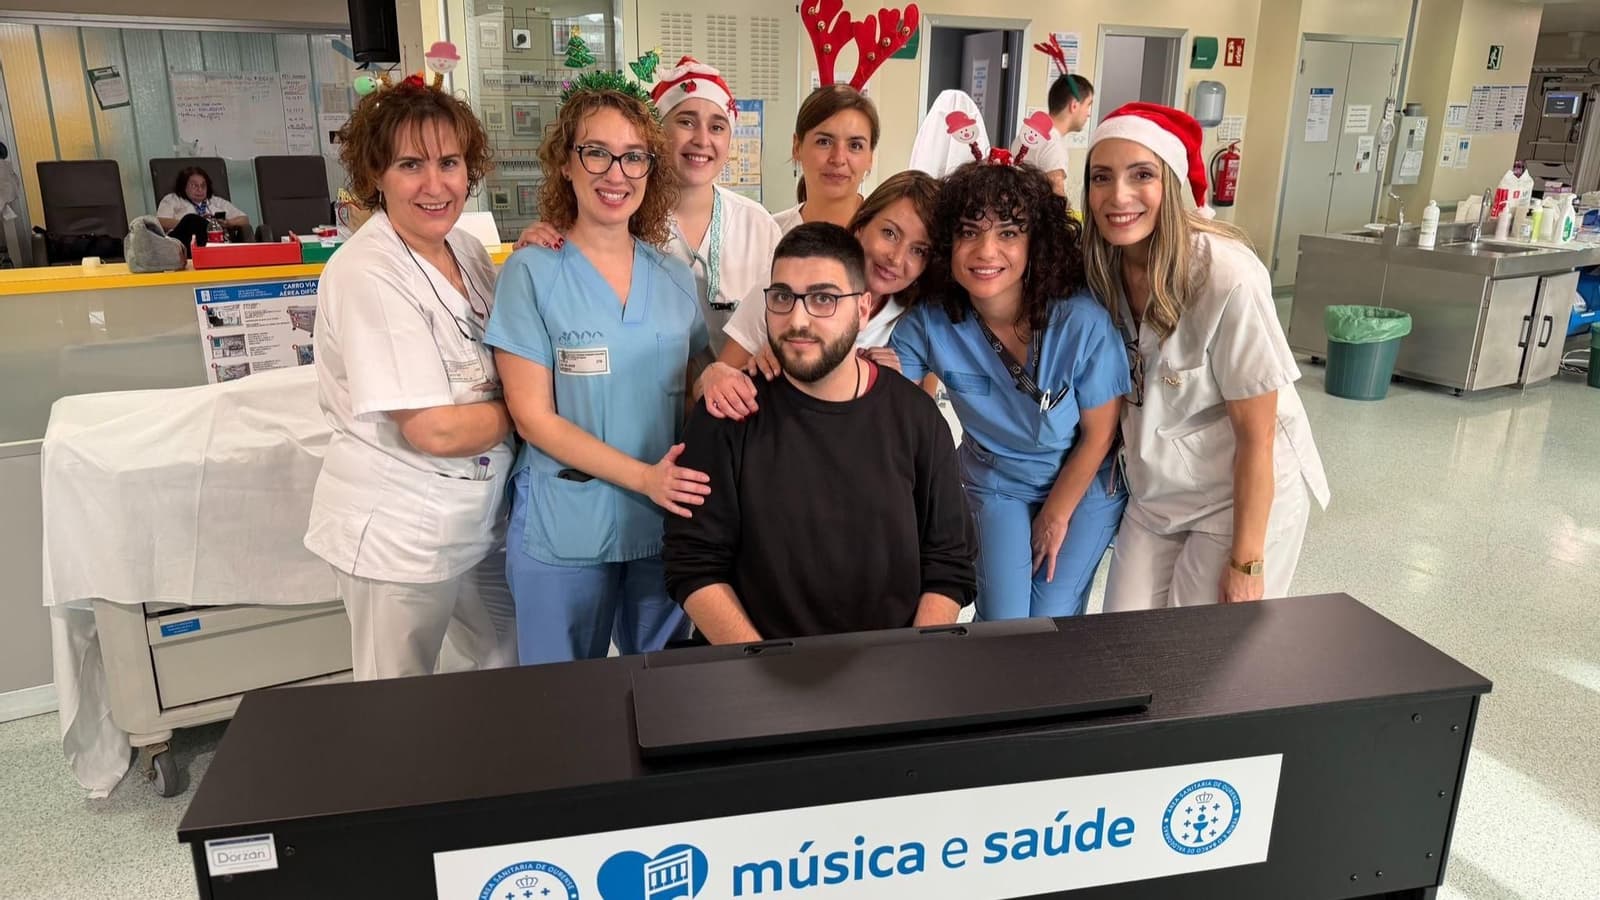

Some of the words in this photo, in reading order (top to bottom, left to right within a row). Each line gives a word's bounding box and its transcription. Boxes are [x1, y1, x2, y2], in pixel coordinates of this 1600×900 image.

[283, 282, 305, 290] CARRO
[733, 836, 925, 897] música
[942, 838, 969, 870] e
[984, 808, 1136, 865] saúde
[495, 863, 533, 882] SANITARIA
[536, 863, 546, 871] DE
[547, 866, 575, 889] OURENSE
